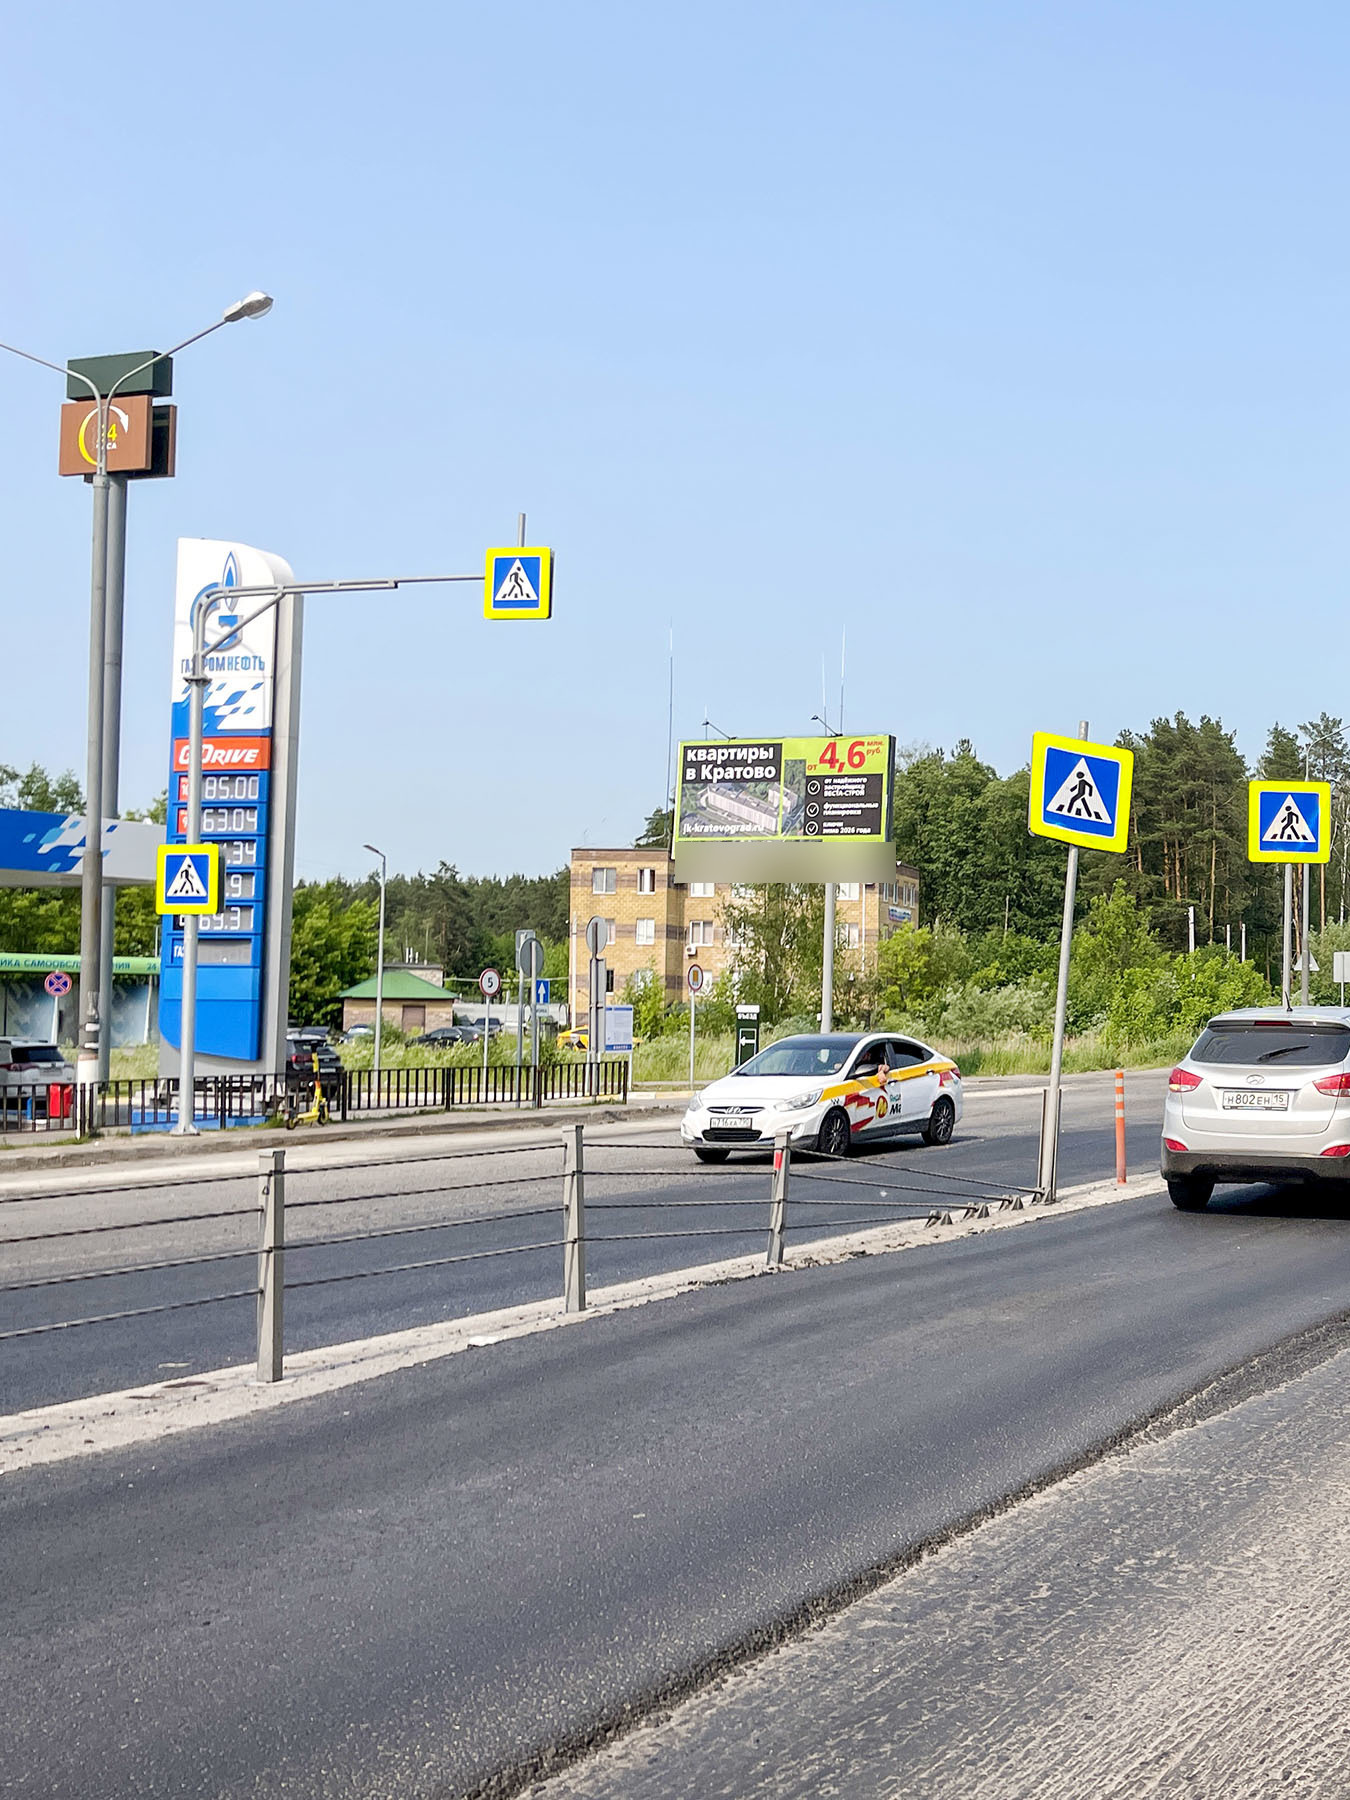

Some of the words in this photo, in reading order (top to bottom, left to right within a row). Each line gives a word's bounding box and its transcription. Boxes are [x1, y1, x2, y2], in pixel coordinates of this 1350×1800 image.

[181, 655, 265, 674] ГАРОМНЕФТЬ
[687, 747, 774, 764] квартиры
[819, 741, 866, 773] 4,6
[686, 768, 696, 780] в
[701, 764, 777, 783] Кратово
[204, 776, 260, 800] 85.00
[202, 808, 258, 833] 63.04
[487, 977, 494, 988] 5
